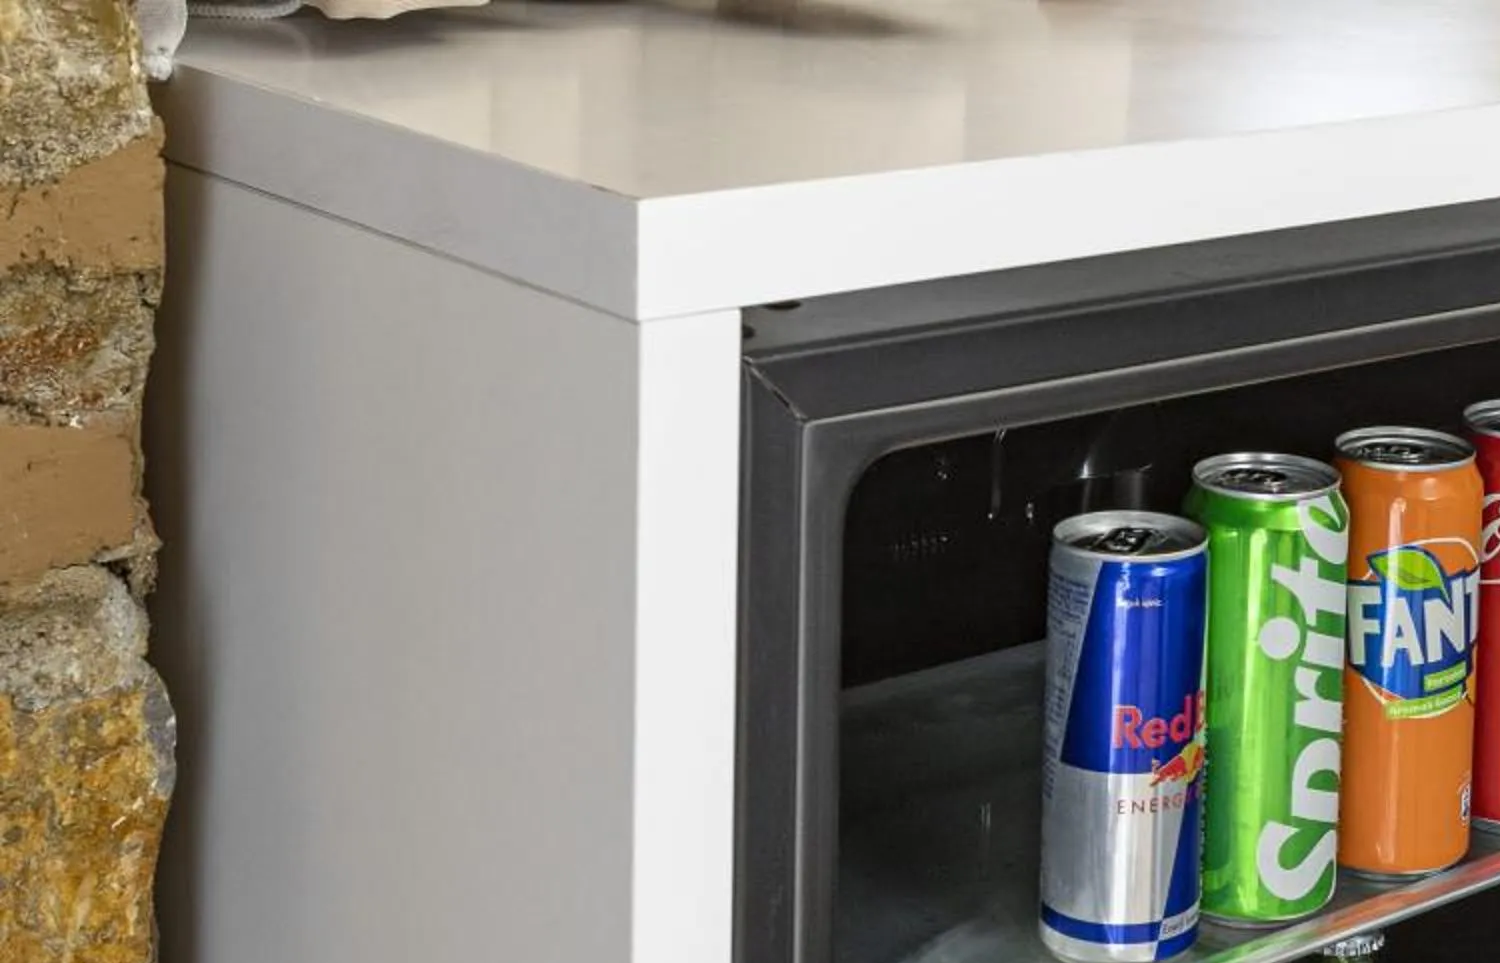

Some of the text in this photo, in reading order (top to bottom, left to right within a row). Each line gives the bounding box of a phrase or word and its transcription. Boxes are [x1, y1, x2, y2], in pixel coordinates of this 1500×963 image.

[1349, 569, 1480, 668] FANT
[1113, 693, 1192, 750] Red
[1255, 487, 1349, 901] Sprite
[1116, 792, 1193, 815] ENERG
